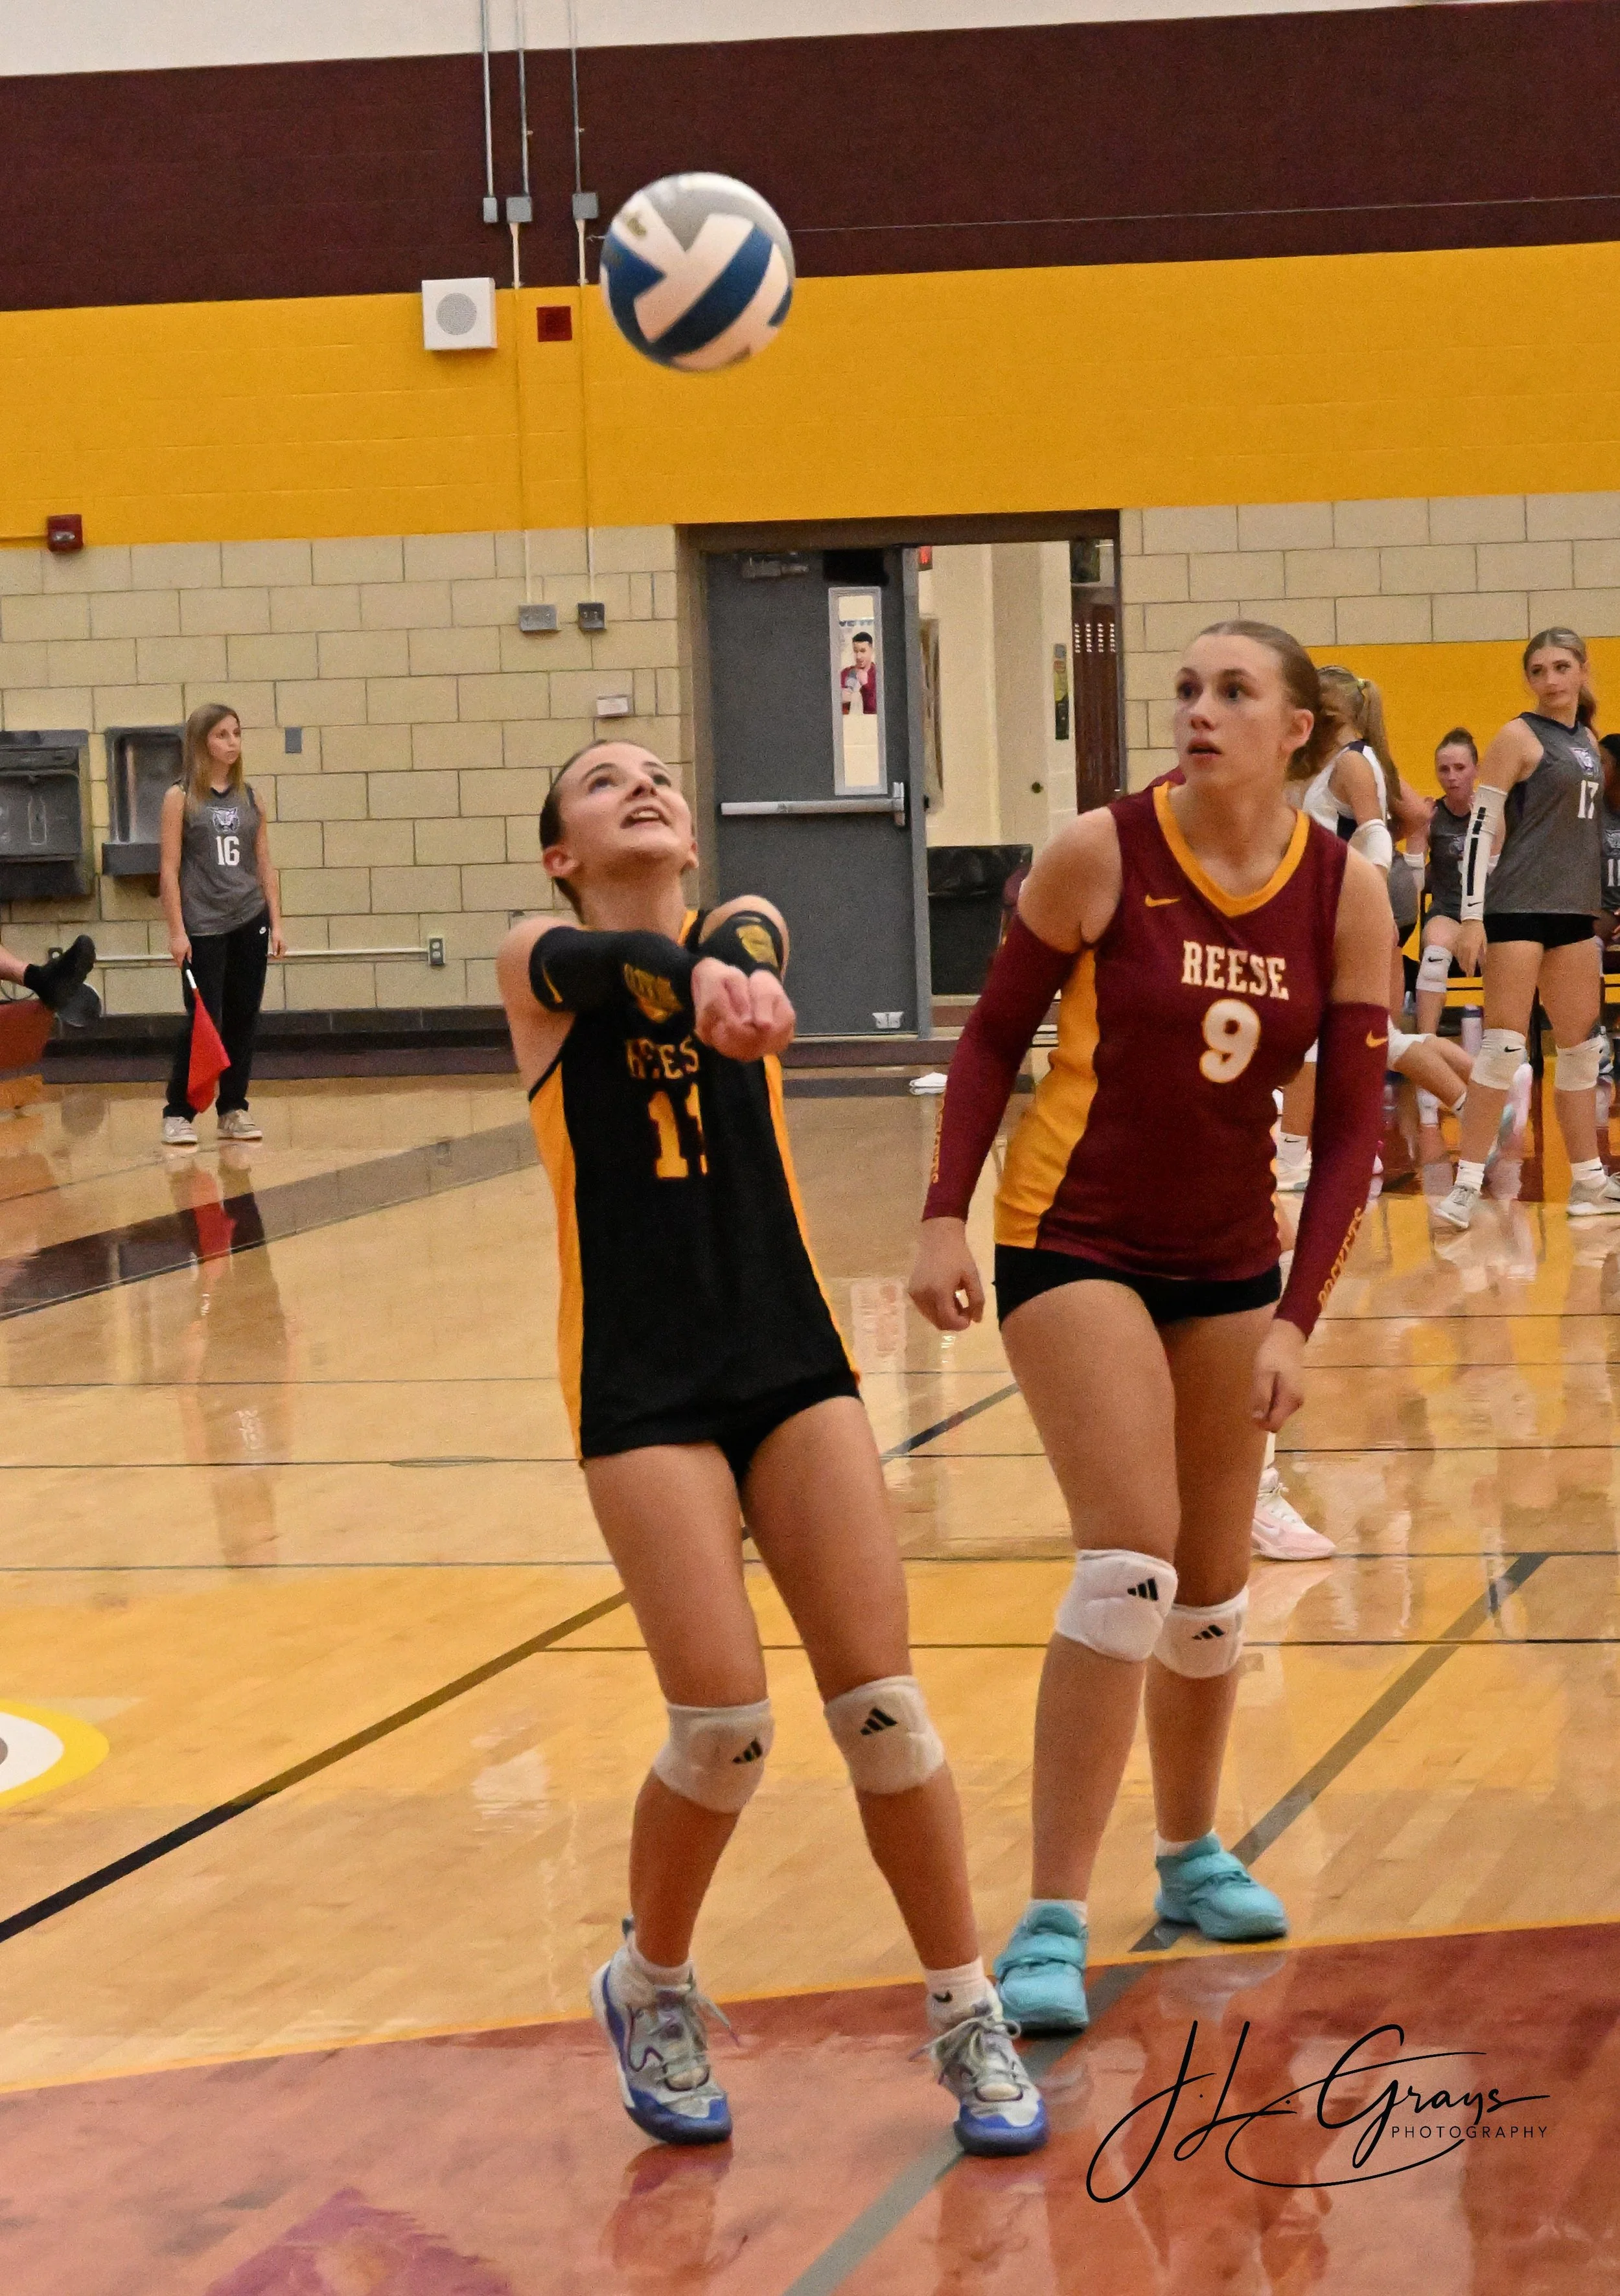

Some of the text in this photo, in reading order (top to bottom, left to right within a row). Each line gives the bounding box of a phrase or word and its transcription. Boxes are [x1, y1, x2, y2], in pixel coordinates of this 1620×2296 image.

[1577, 779, 1599, 819] 17
[216, 835, 240, 866] 16
[1181, 939, 1290, 1000] REESE
[1199, 998, 1262, 1084] 9
